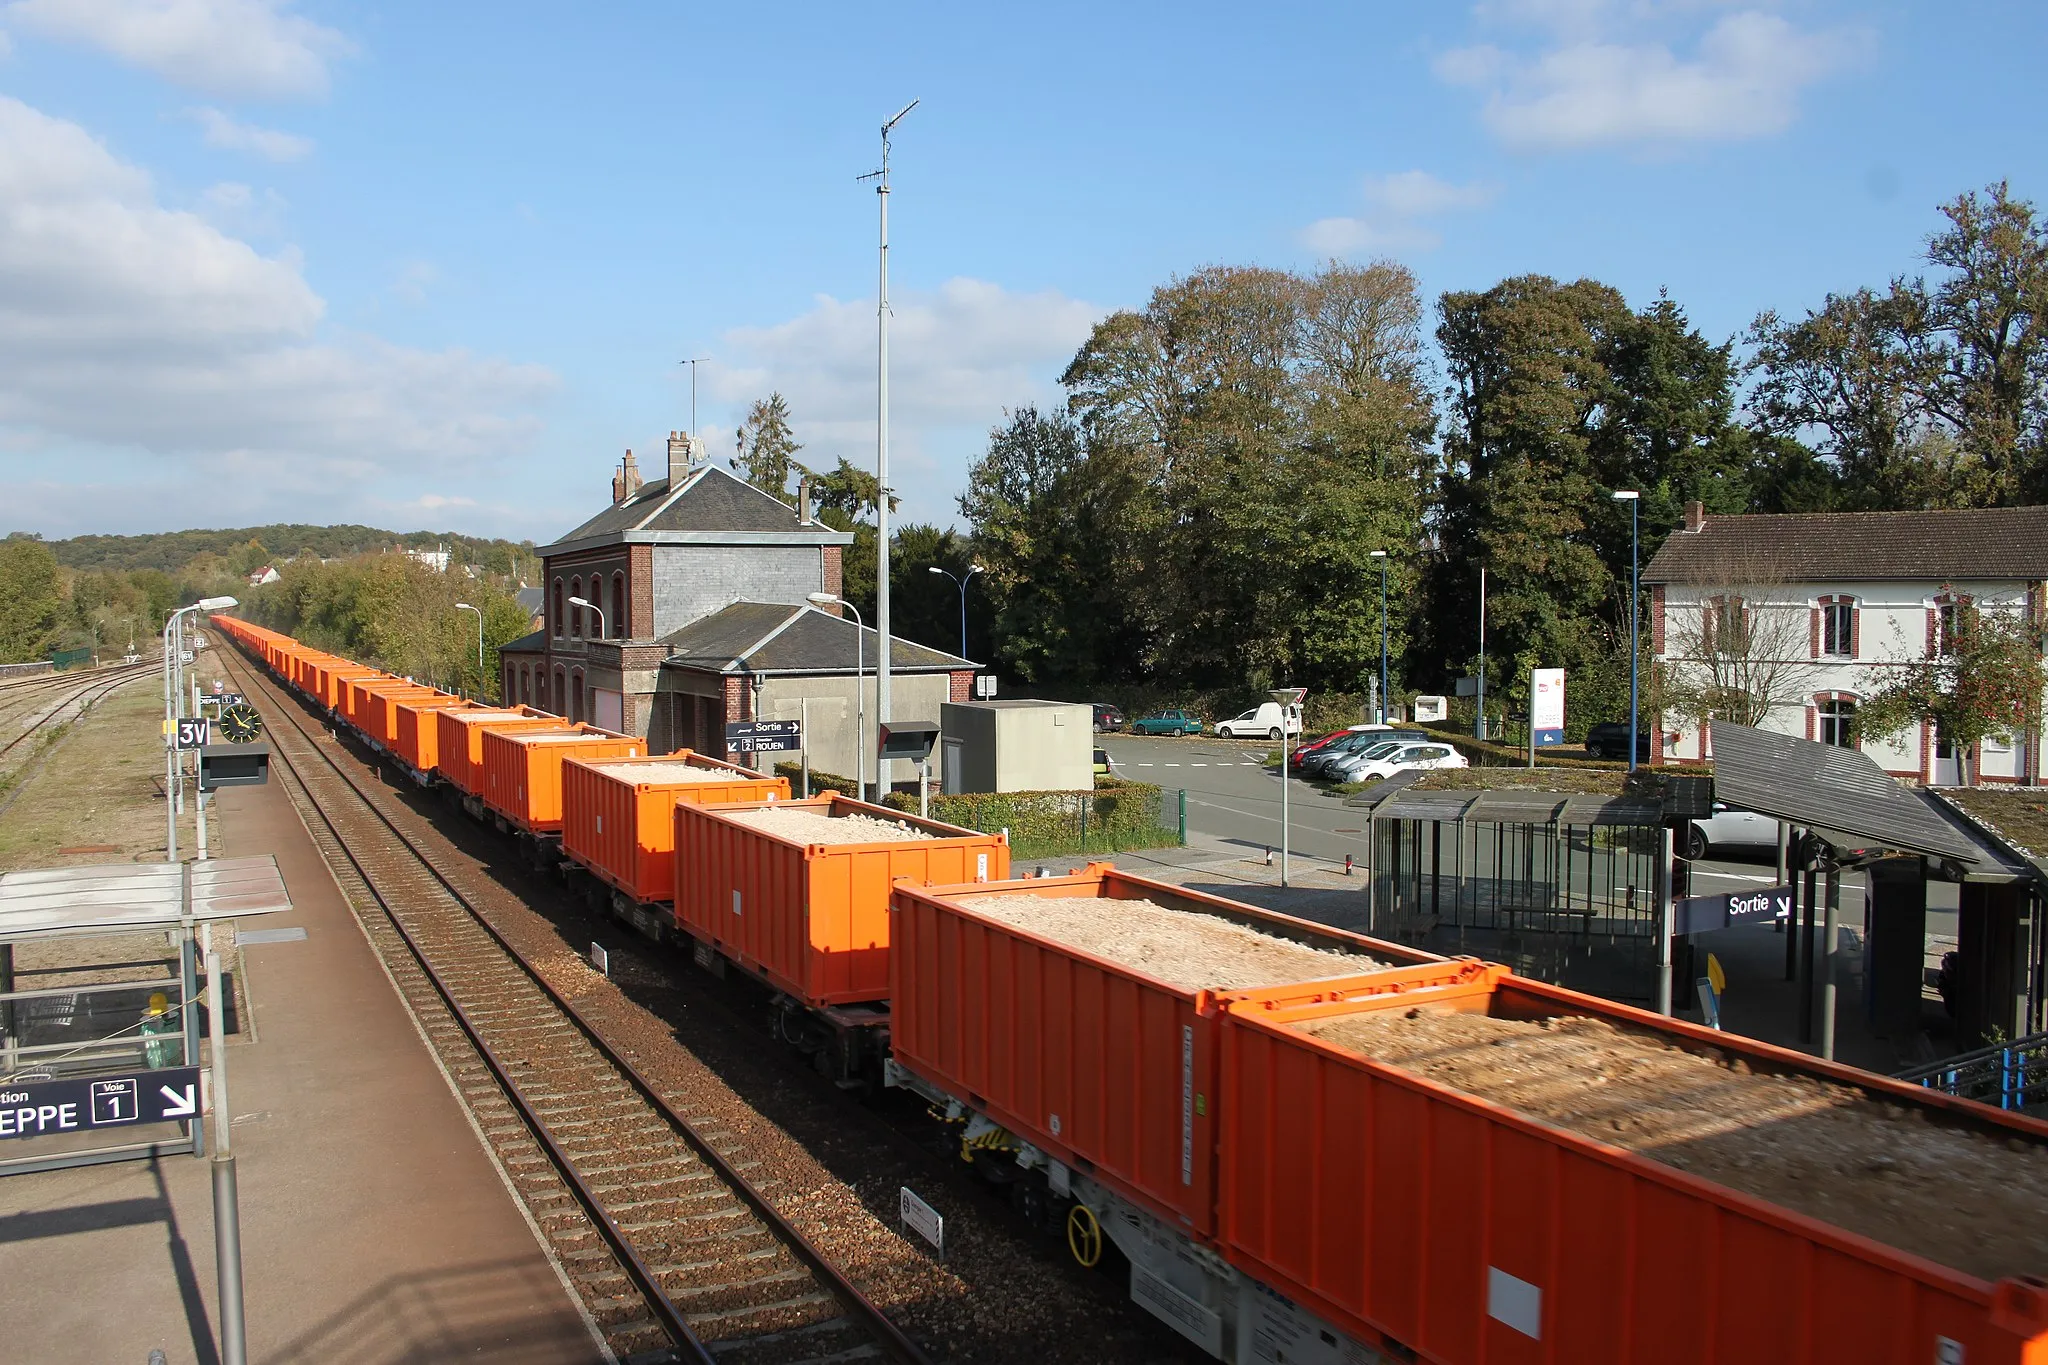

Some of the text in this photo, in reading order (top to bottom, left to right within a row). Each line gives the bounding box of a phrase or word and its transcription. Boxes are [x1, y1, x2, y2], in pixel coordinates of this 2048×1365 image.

[180, 723, 206, 744] 3V
[755, 722, 782, 732] Sortie
[756, 742, 784, 751] ROUEN
[1729, 893, 1769, 915] Sortie
[103, 1083, 125, 1093] Voie
[0, 1090, 29, 1104] tion
[108, 1096, 120, 1119] 1
[0, 1102, 78, 1135] EPPE
